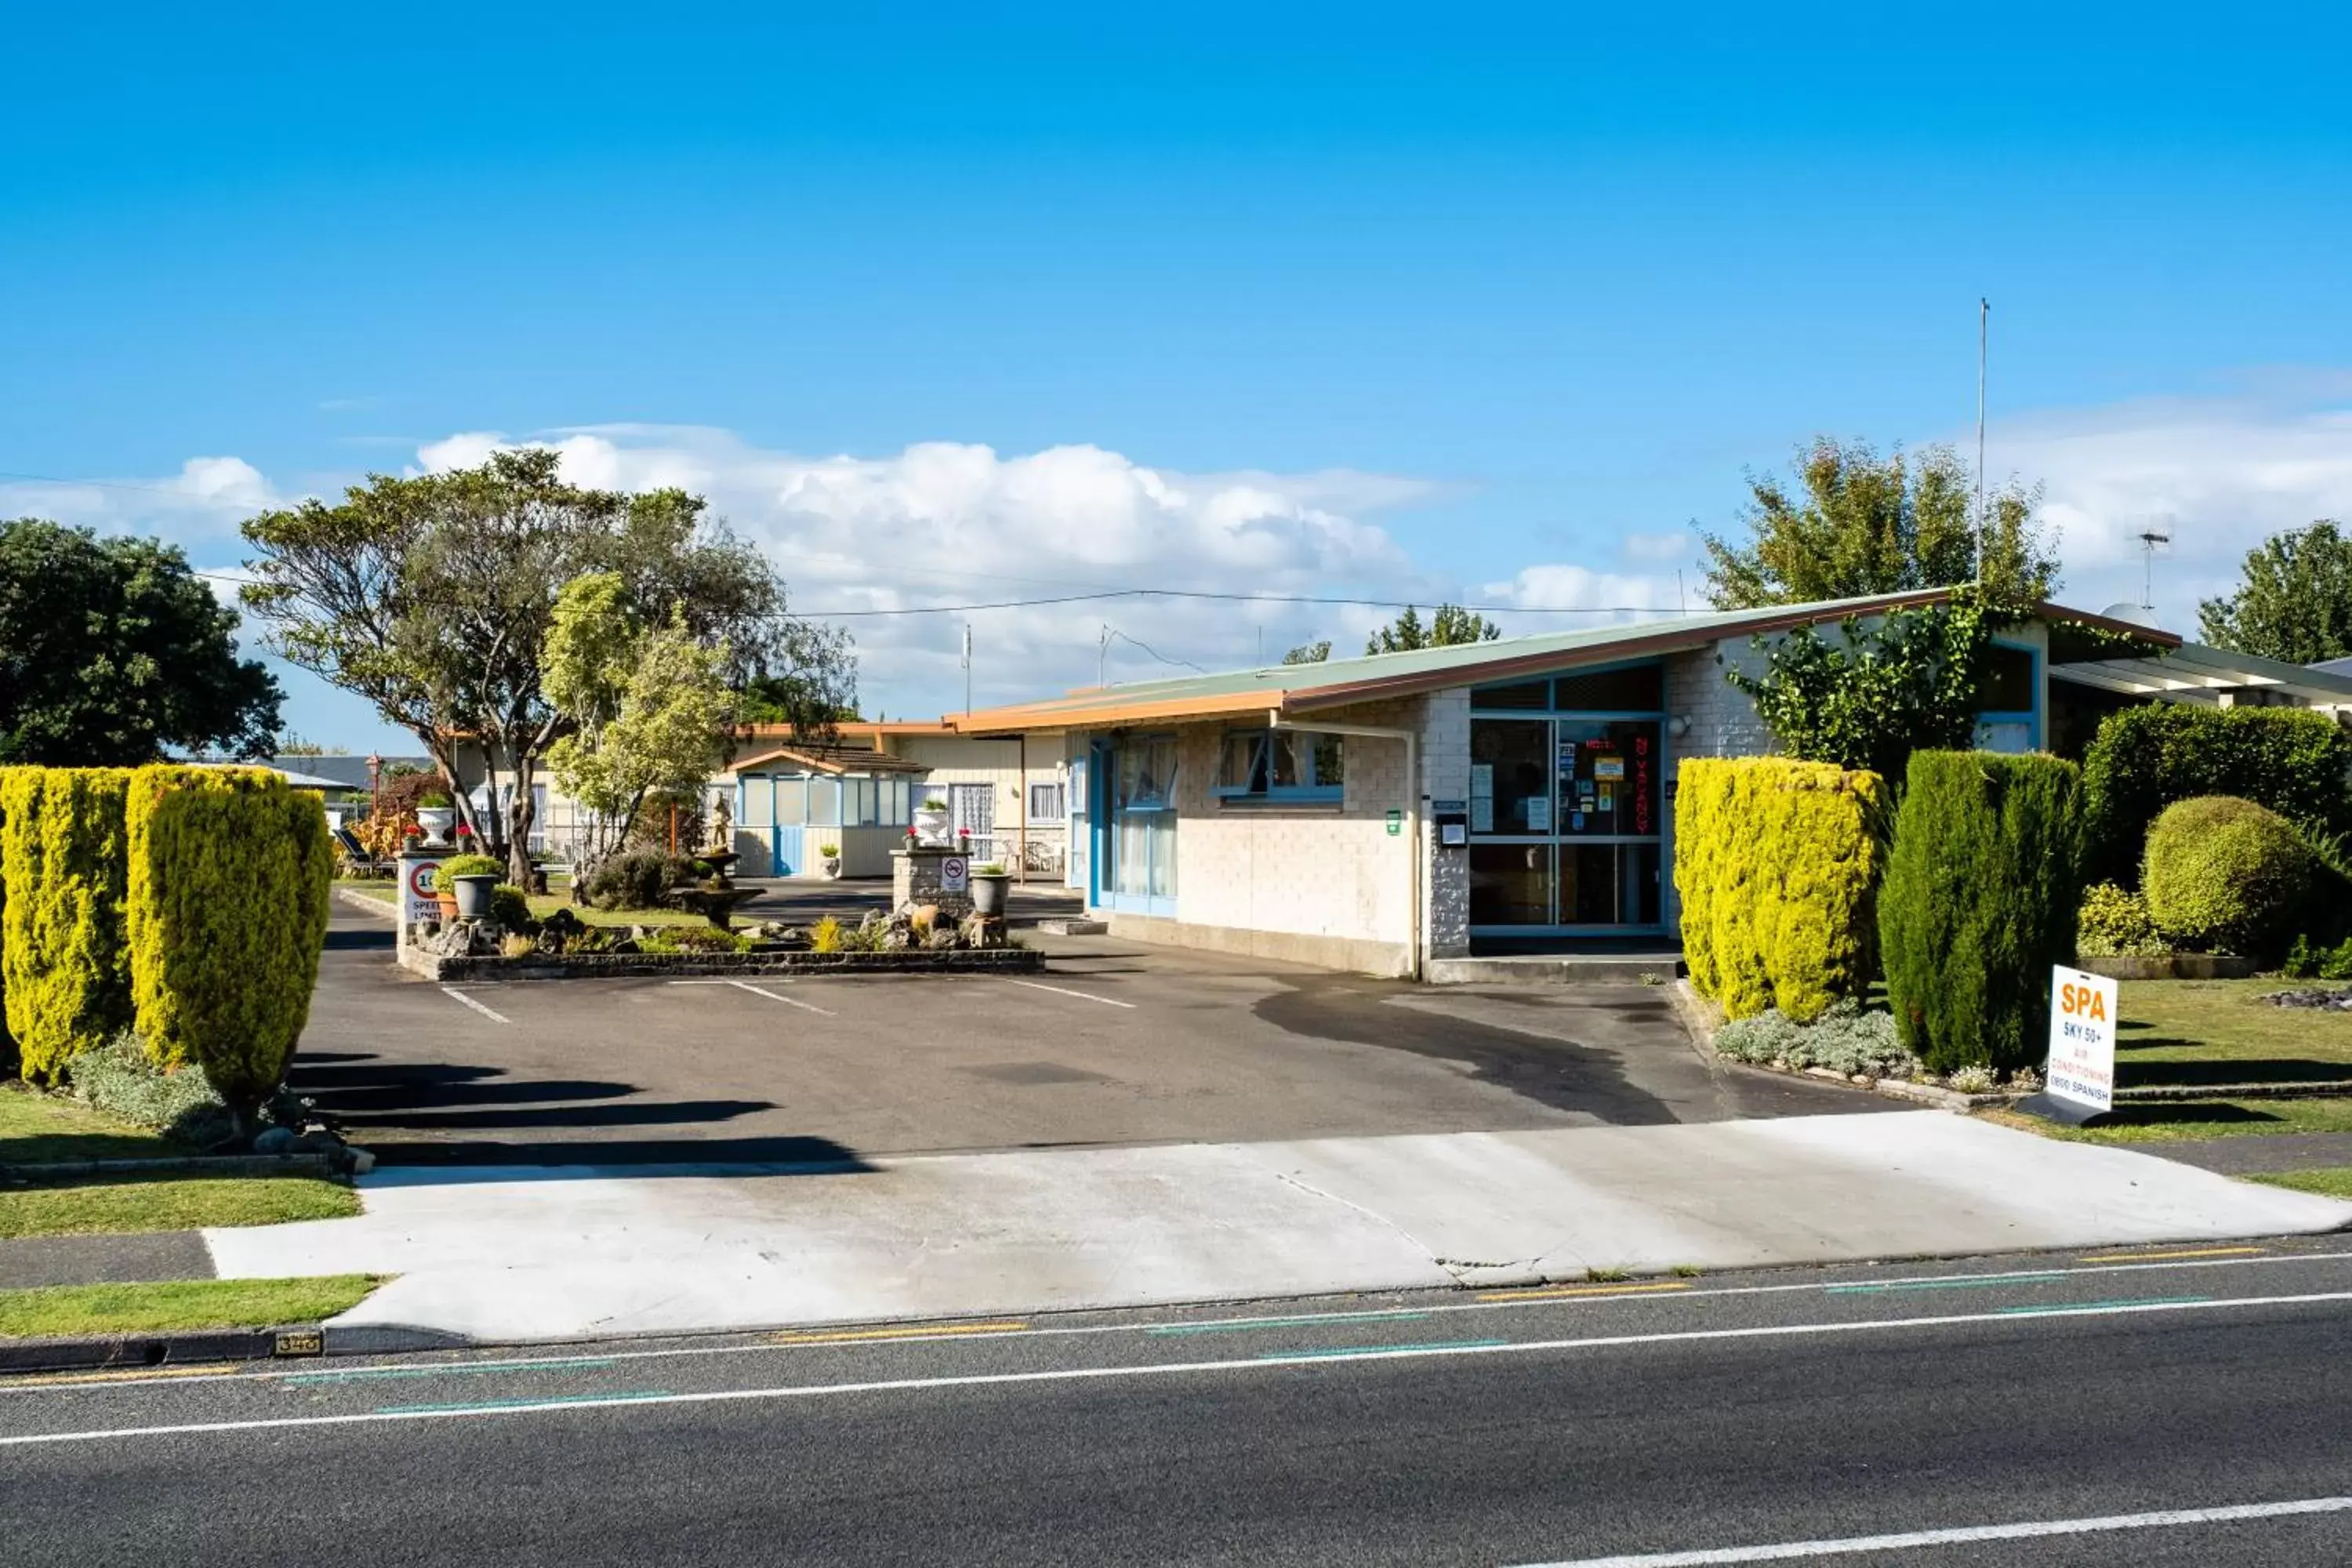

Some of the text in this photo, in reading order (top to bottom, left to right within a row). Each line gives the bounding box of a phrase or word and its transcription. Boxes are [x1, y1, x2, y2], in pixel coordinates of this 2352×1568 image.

[1635, 759, 1648, 835] VACANCY
[2062, 983, 2106, 1022] SPA
[2063, 1022, 2102, 1044] SKY 50+
[2052, 1058, 2110, 1084] CONDITIONING
[2050, 1075, 2108, 1102] 0800 SPANISH
